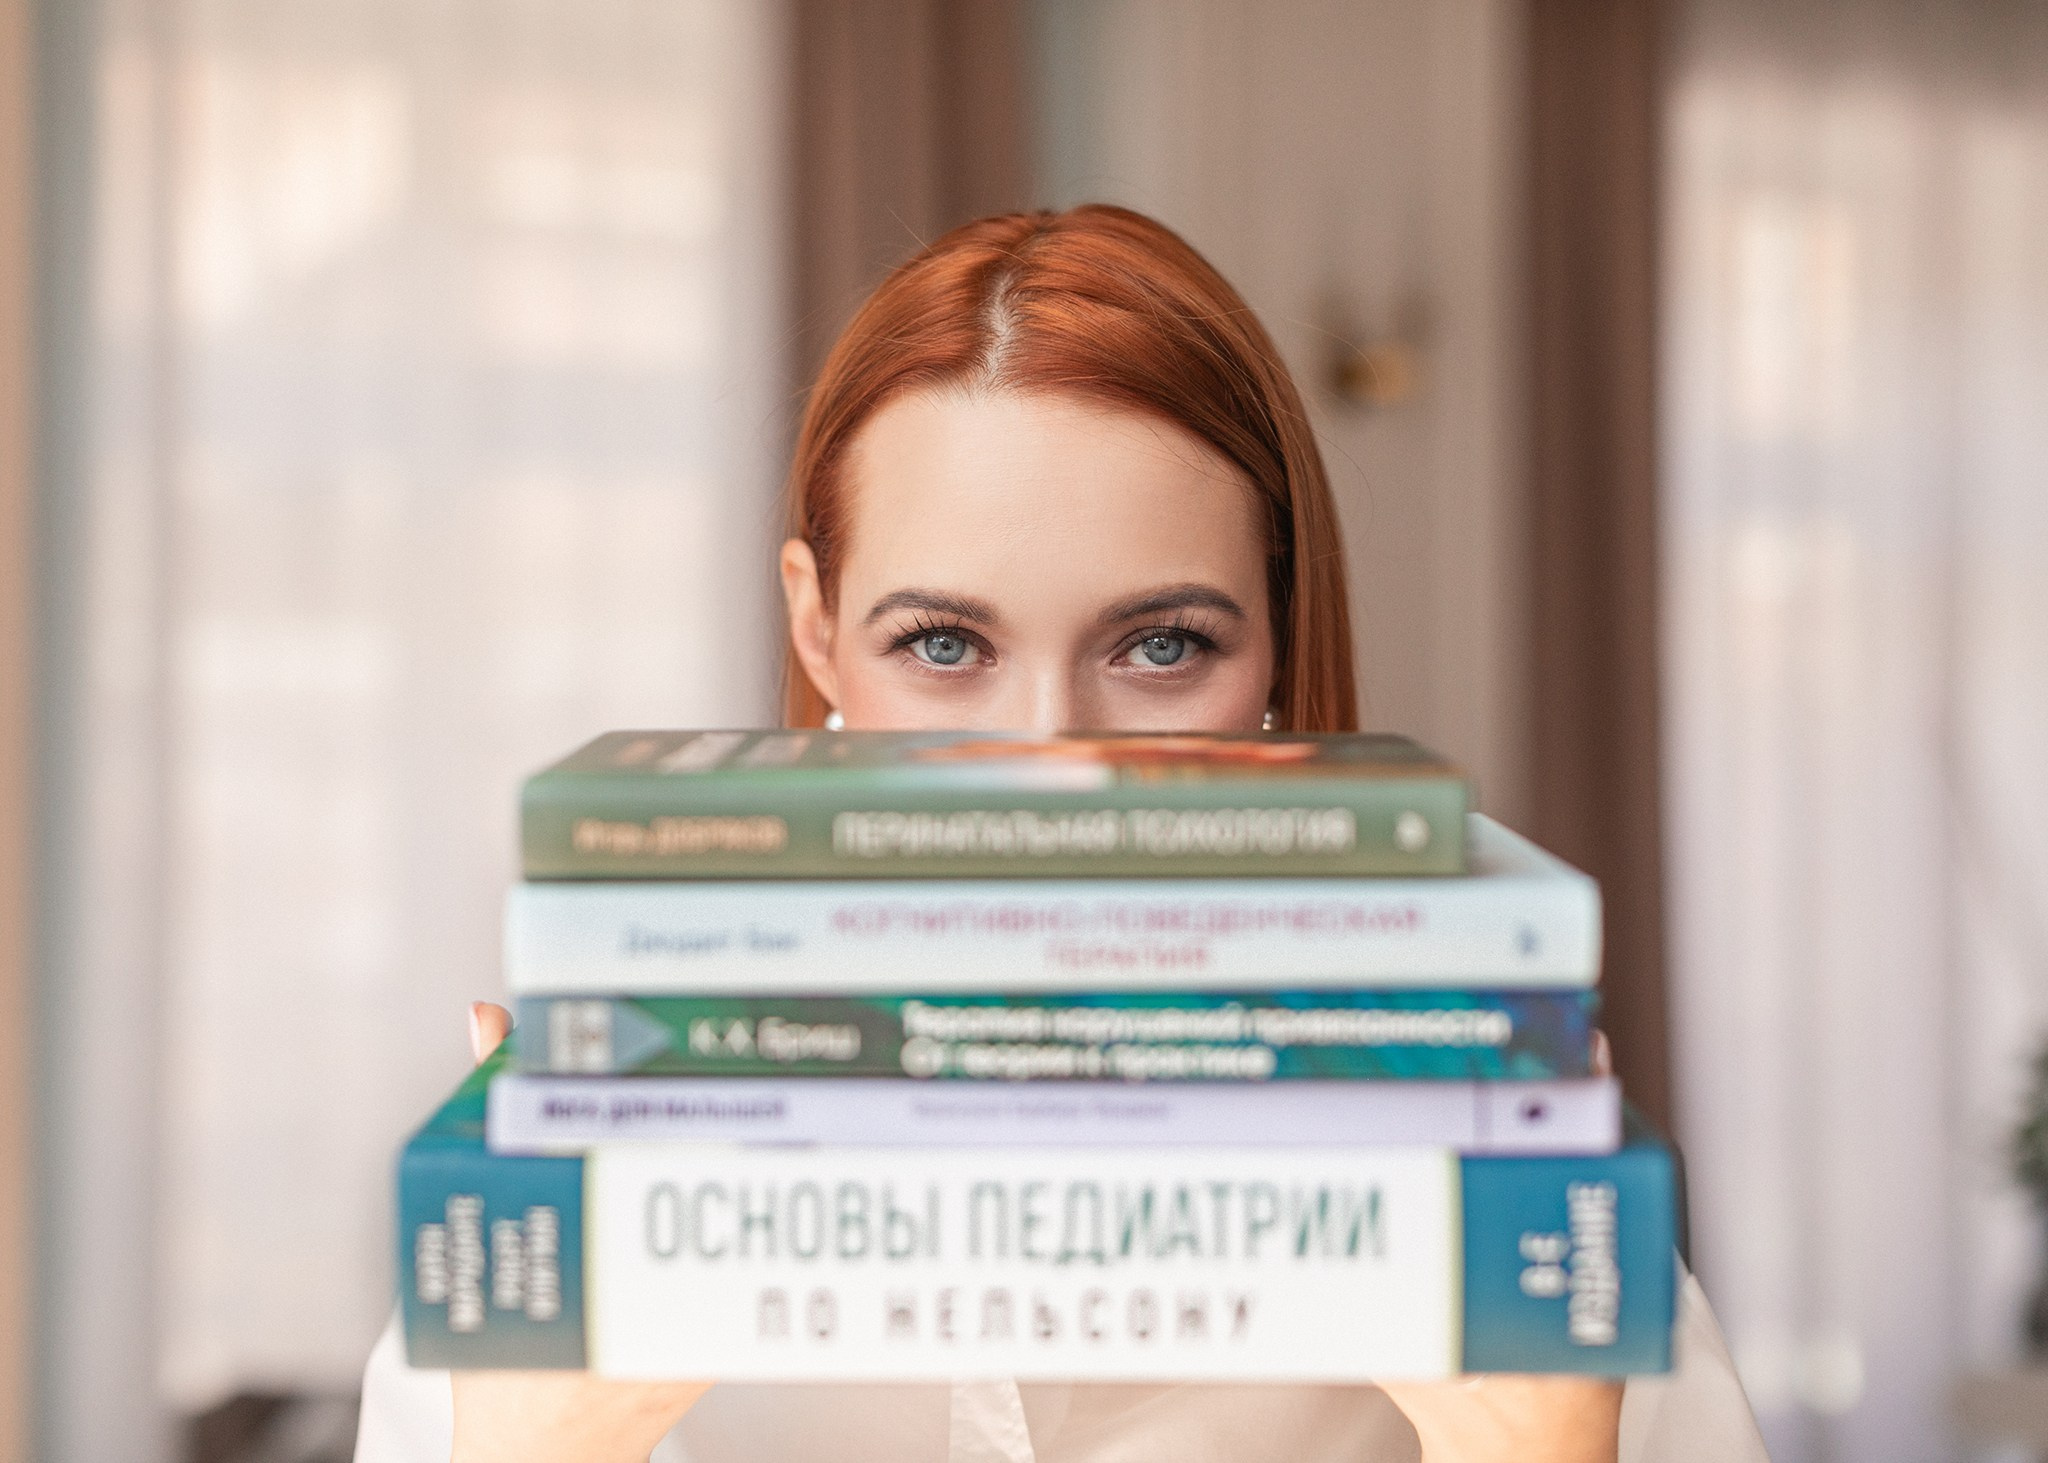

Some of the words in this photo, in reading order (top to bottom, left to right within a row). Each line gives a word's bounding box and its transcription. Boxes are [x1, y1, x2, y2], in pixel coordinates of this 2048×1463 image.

[834, 811, 1120, 856] ПЕРИНАТАЛЬНАЯ
[1130, 810, 1355, 856] ПСИХОЛОГИЯ
[645, 1180, 943, 1261] ОСНОВЫ
[967, 1180, 1386, 1266] ПЕДИАТРИИ
[757, 1285, 838, 1341] ПО
[886, 1285, 1256, 1342] НЕЛЬСОНУ
